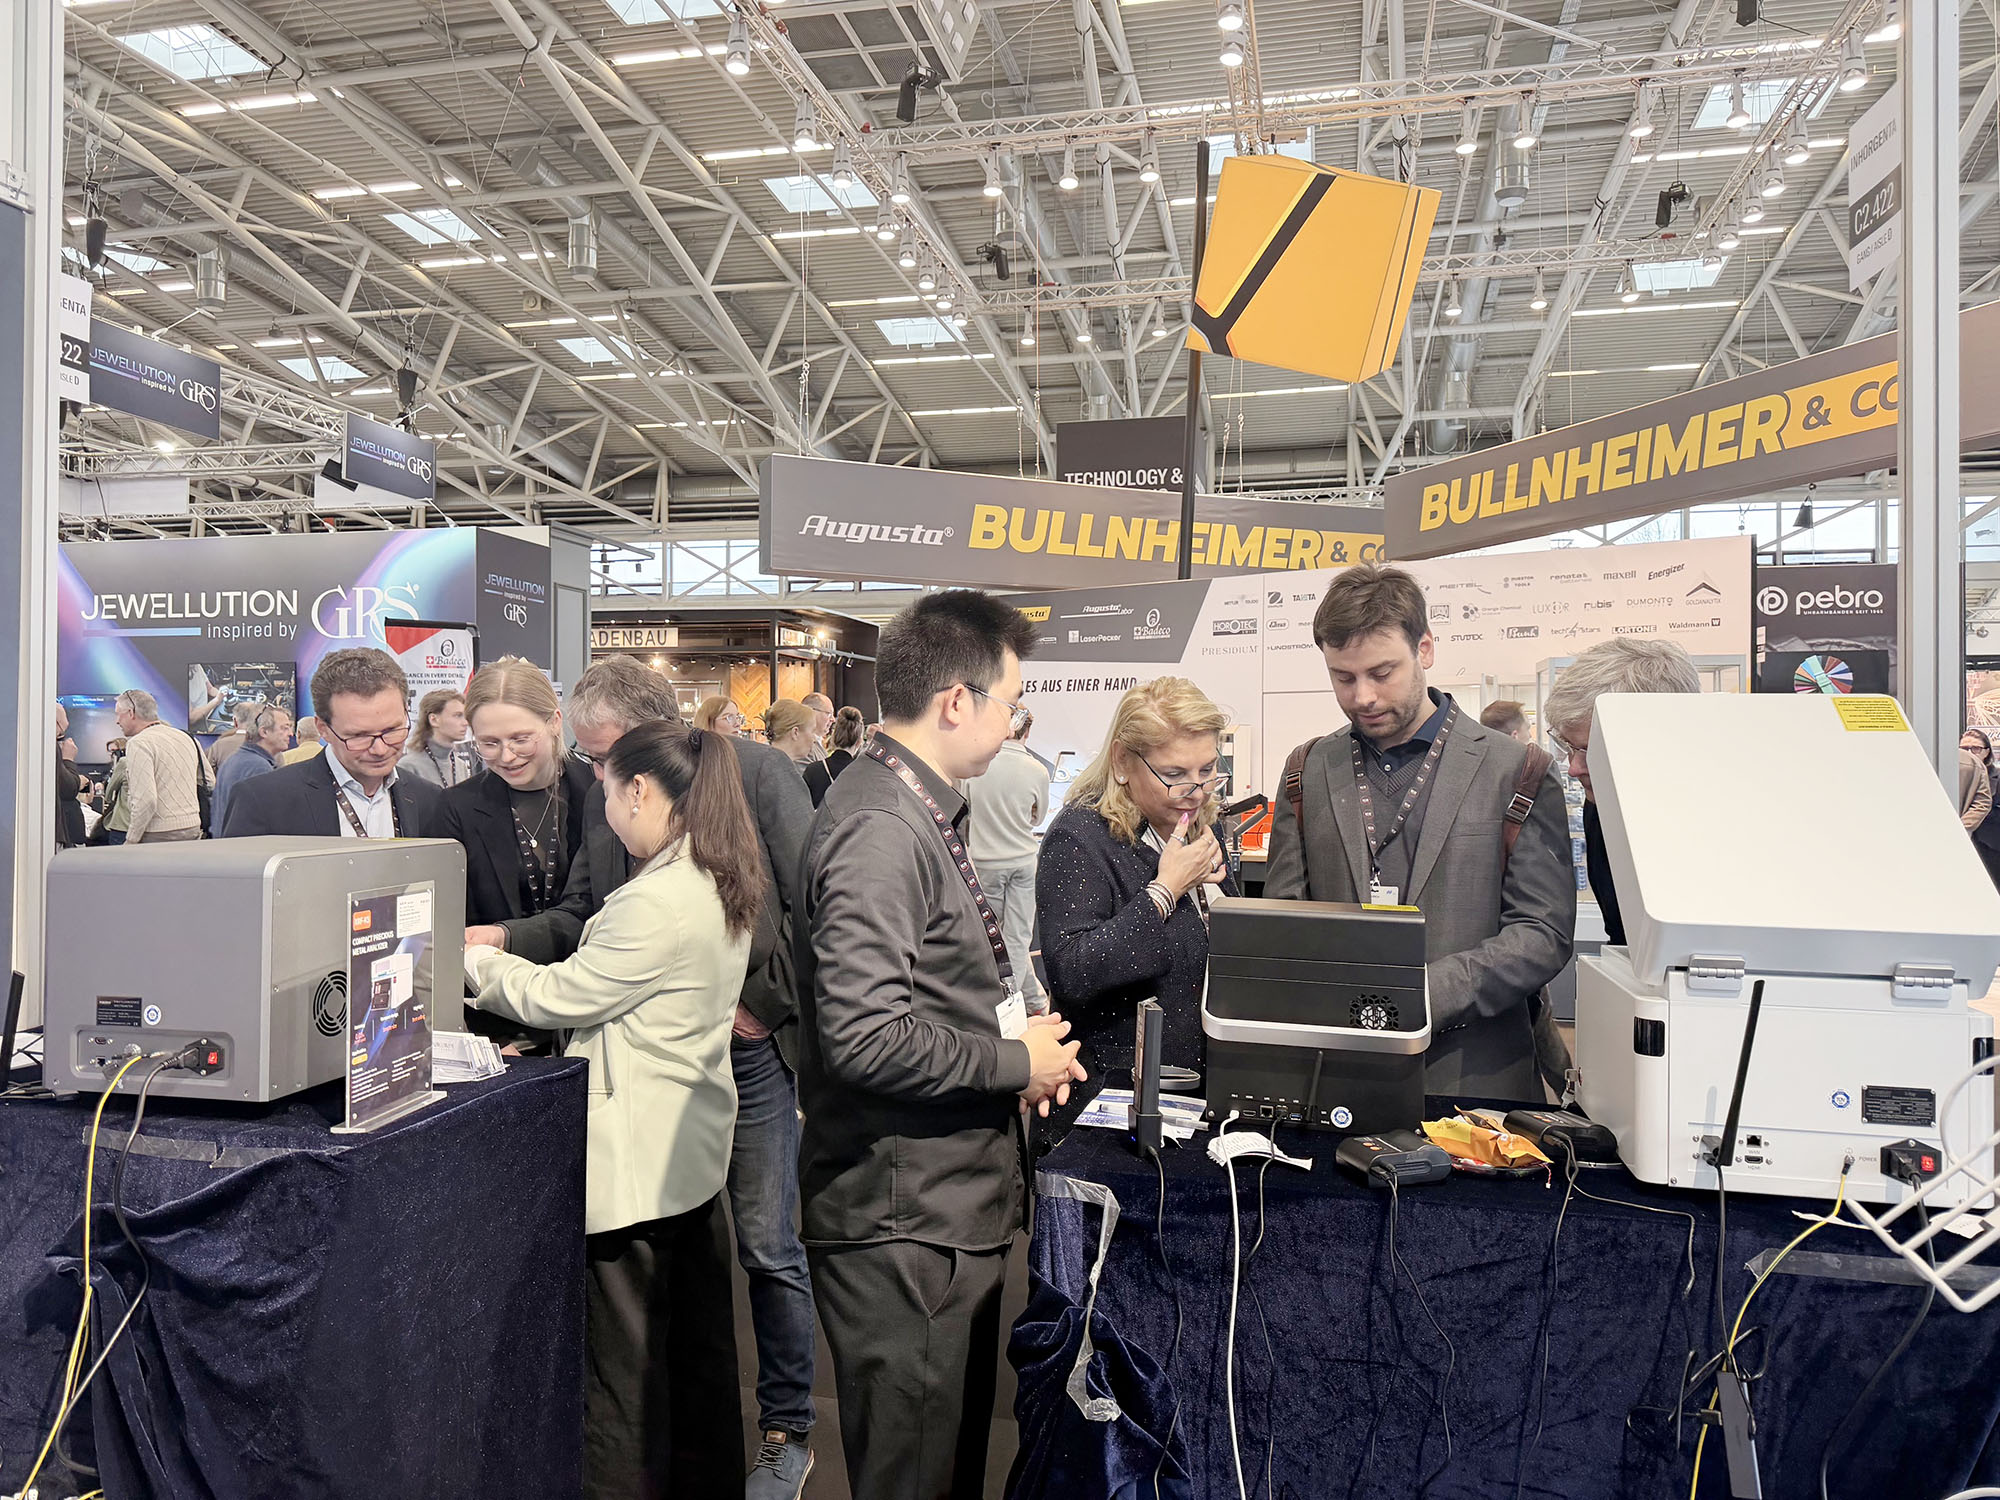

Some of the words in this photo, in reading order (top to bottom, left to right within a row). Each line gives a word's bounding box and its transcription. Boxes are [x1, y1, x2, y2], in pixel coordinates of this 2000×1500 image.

[1850, 118, 1897, 172] INHORGENTA
[1854, 181, 1894, 235] C2.422
[60, 297, 87, 317] ENTA
[60, 340, 83, 365] 22
[89, 347, 176, 386] JEWELLUTION
[141, 377, 167, 391] inspired
[168, 383, 176, 396] by
[350, 436, 406, 463] JEWELLUTION
[1419, 394, 1788, 532] BULLNHEIMER
[1802, 395, 1832, 430] &
[1064, 468, 1168, 487] TECHNOLOGY
[1170, 467, 1183, 484] &
[968, 504, 1320, 570] BULLNHEIMER
[1330, 541, 1349, 563] &
[1603, 570, 1637, 580] maxell
[1648, 563, 1685, 580] Energizer
[484, 573, 545, 596] JEWELLUTION
[81, 590, 298, 620] JEWELLUTION
[1795, 585, 1884, 615] pebro
[207, 622, 272, 641] inspired
[279, 622, 298, 641] by
[1213, 619, 1257, 633] HOROTEC
[1611, 625, 1658, 634] LORTONE
[590, 629, 668, 647] ADENBAU
[1080, 634, 1121, 643] LaserPecker
[1202, 645, 1257, 655] PRESIDIUM
[1021, 680, 1037, 693] ES
[1041, 680, 1062, 693] AUS
[1066, 678, 1099, 691] EINER
